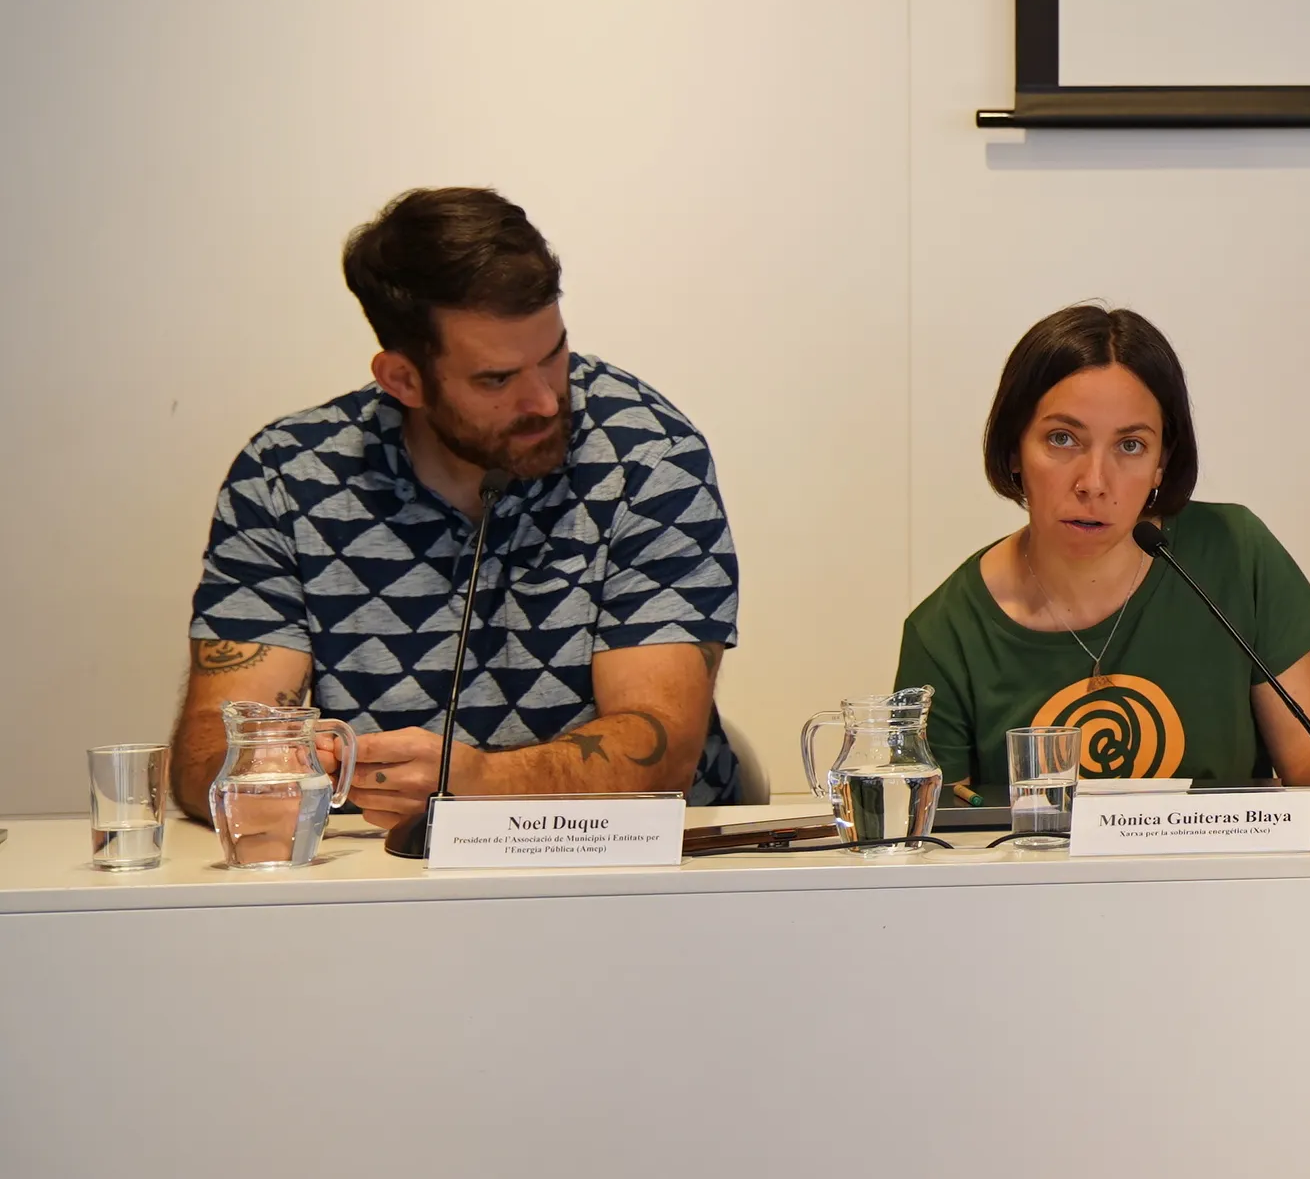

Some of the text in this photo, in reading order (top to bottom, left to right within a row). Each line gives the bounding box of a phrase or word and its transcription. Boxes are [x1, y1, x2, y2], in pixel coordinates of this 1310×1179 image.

[507, 815, 610, 834] Noel Duque
[1099, 810, 1292, 827] Mònica Guiteras Blaya
[453, 836, 492, 844] President
[493, 836, 503, 844] de
[553, 835, 564, 843] de
[566, 834, 606, 843] Municipis
[613, 834, 644, 842] Entitats
[645, 834, 660, 843] per
[544, 845, 575, 853] Pública
